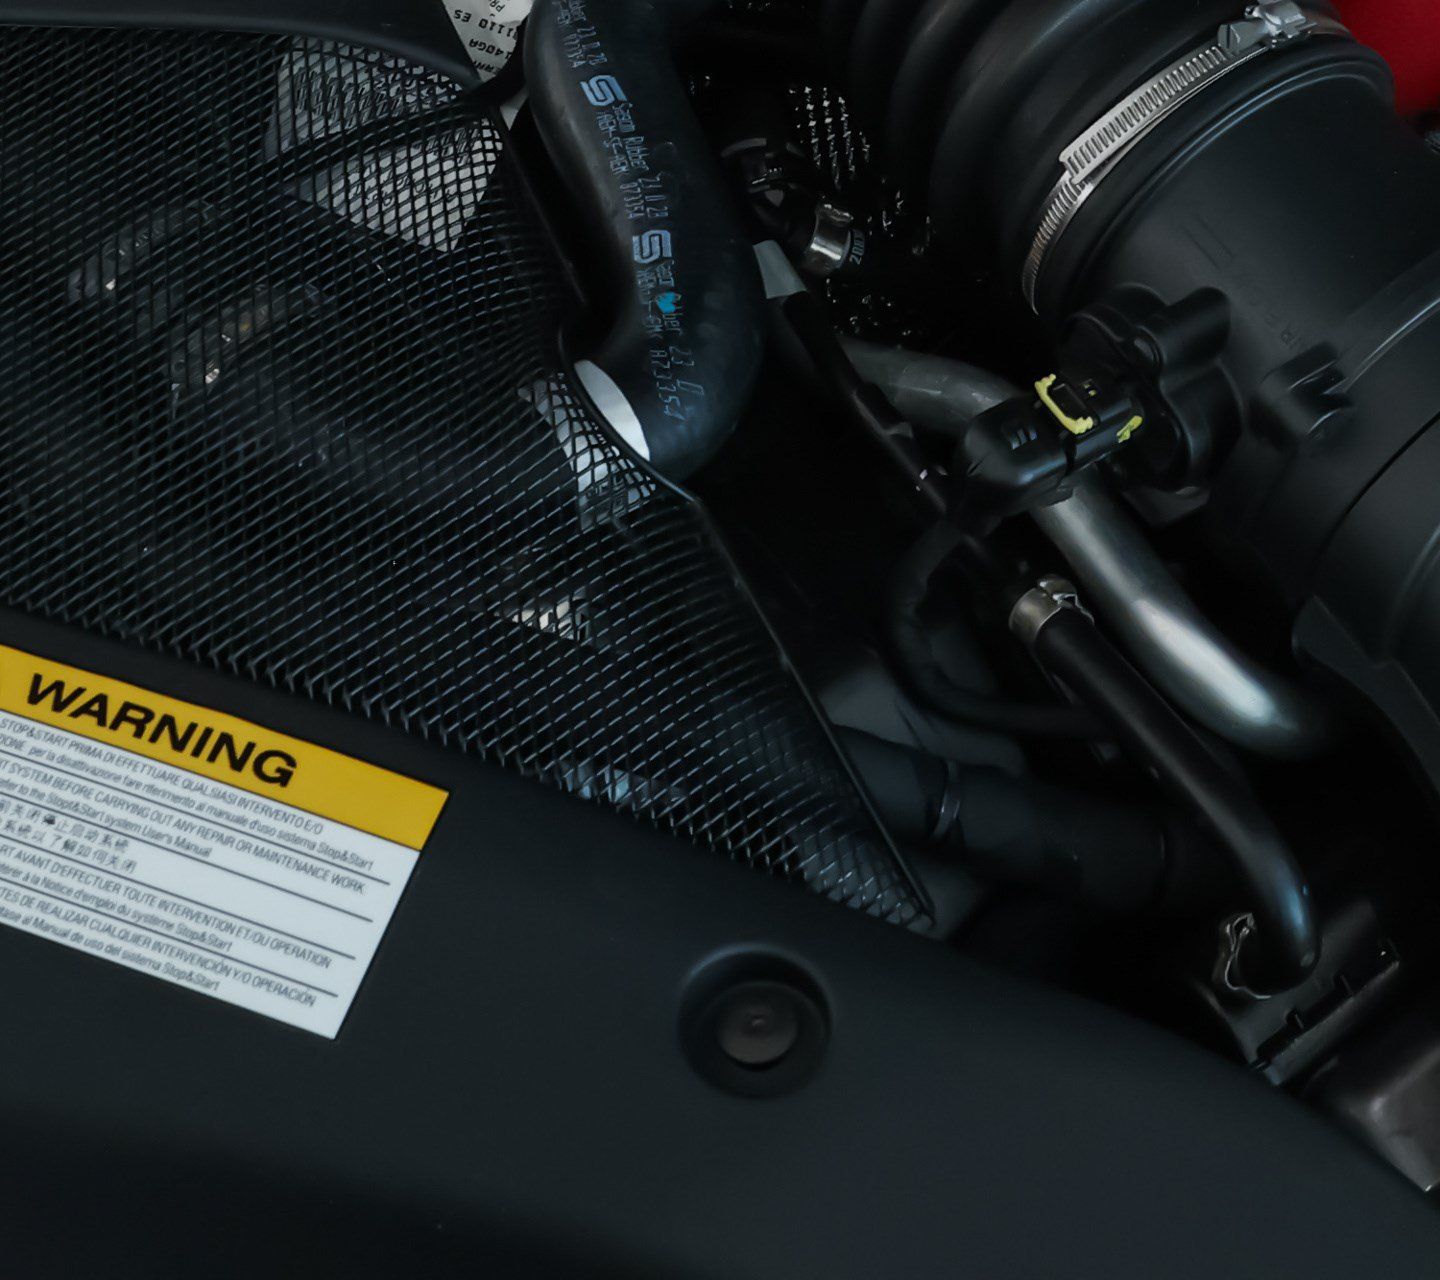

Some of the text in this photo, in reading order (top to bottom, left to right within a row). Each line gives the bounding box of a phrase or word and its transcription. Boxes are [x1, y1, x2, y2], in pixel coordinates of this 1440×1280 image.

[453, 10, 472, 24] ES
[25, 672, 299, 790] WARNING
[0, 719, 67, 746] STOP&START
[68, 741, 103, 759] PRIMA
[102, 752, 117, 764] DI
[115, 756, 180, 786] EFFETTUARE
[181, 778, 238, 805] QUALSIASI
[237, 797, 304, 828] INTERVENTO
[8, 763, 53, 785] SYSTEM
[51, 778, 93, 800] BEFORE
[94, 792, 150, 818] CARRYING
[149, 811, 174, 826] OUT
[172, 819, 197, 834] ANY
[196, 826, 236, 848] REPAIR
[235, 839, 253, 854] OR
[253, 846, 330, 881] MAINTENANCE
[331, 874, 365, 893] WORK
[174, 836, 212, 857] Manual
[276, 830, 317, 851] sistema
[317, 842, 373, 870] Stop&Start
[14, 850, 51, 869] AVANT
[50, 862, 122, 894] D'EFFECTUER
[123, 886, 157, 907] TOUTE
[158, 899, 236, 934] INTERVENTION
[235, 925, 271, 947] ET/OU
[270, 938, 332, 968] OPERATION
[176, 923, 232, 951] Stop&Start
[19, 895, 36, 909] DE
[36, 900, 89, 927] REALIZAR
[89, 919, 152, 948] CUALQUIER
[232, 968, 252, 984] Y/O
[252, 976, 316, 1006] OPERACIÓN
[163, 963, 220, 990] Stop&Start
